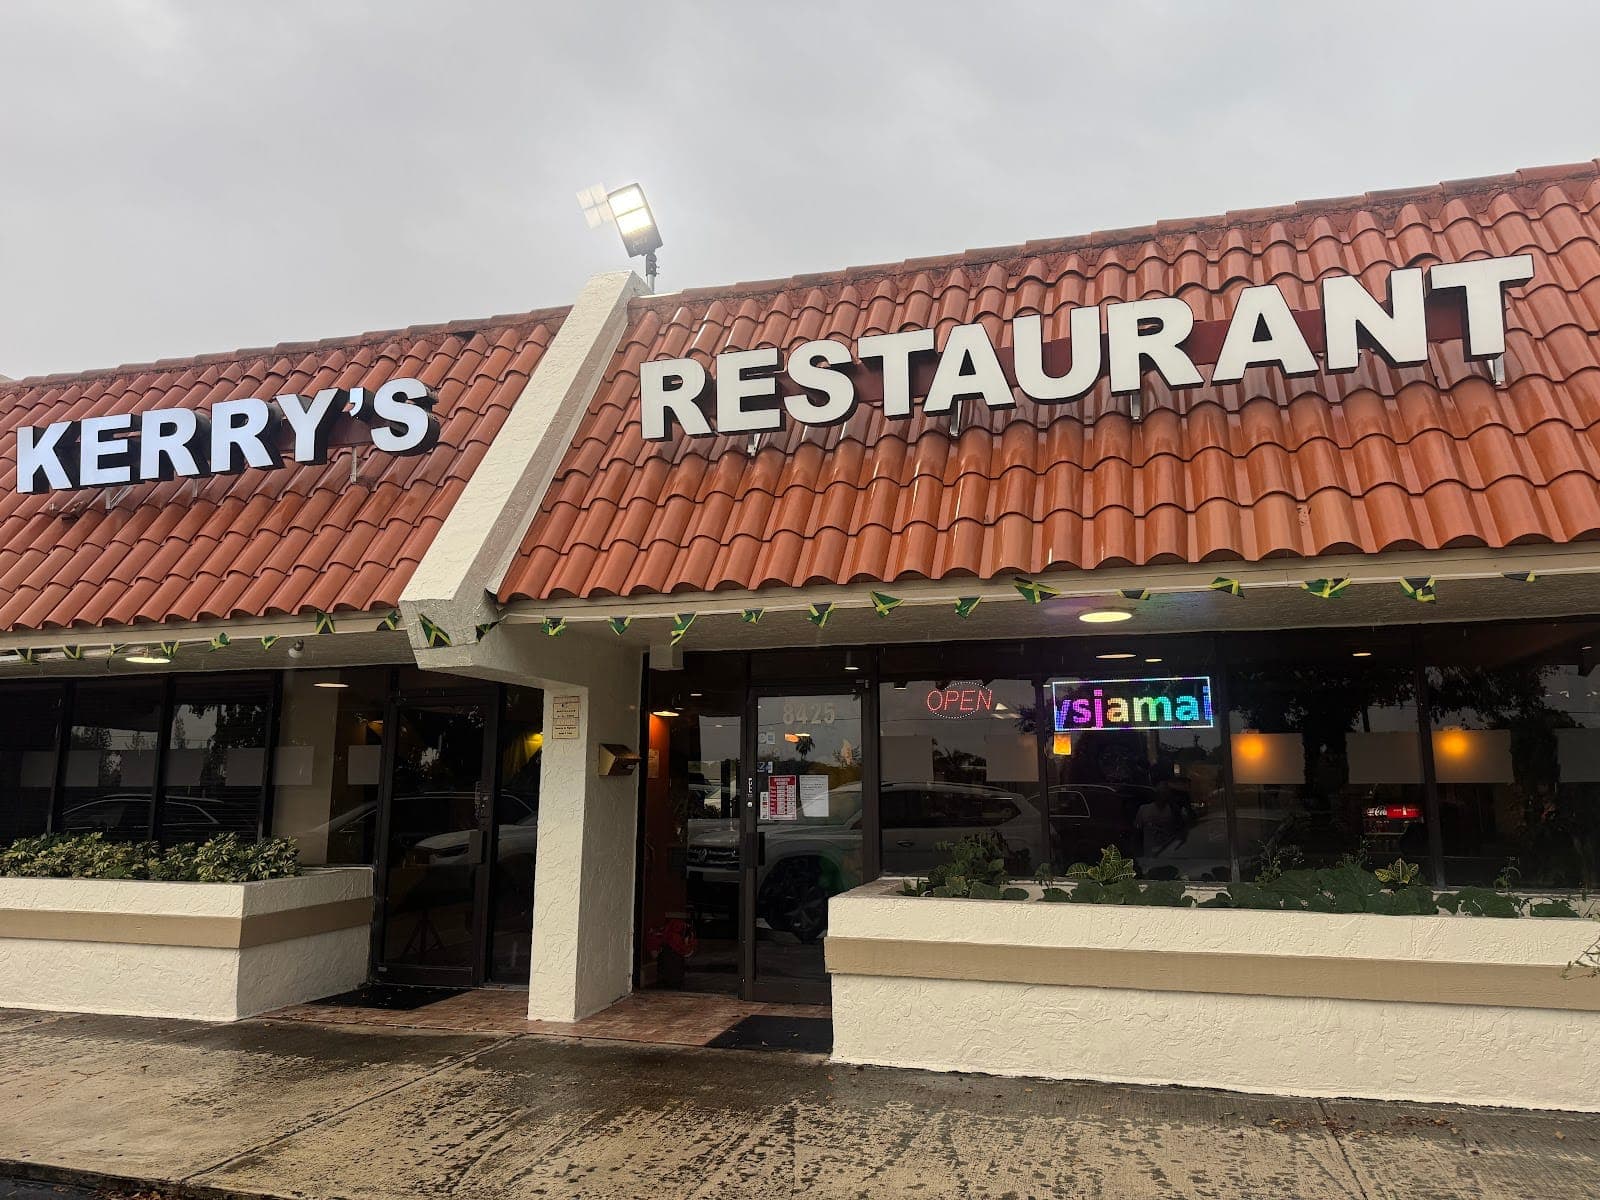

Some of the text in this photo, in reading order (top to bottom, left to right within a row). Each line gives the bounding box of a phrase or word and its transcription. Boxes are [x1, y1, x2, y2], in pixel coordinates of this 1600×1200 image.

[639, 254, 1535, 441] RESTAURANT
[16, 377, 435, 494] KERRY'S
[782, 702, 836, 725] 8425
[926, 688, 993, 712] OPEN
